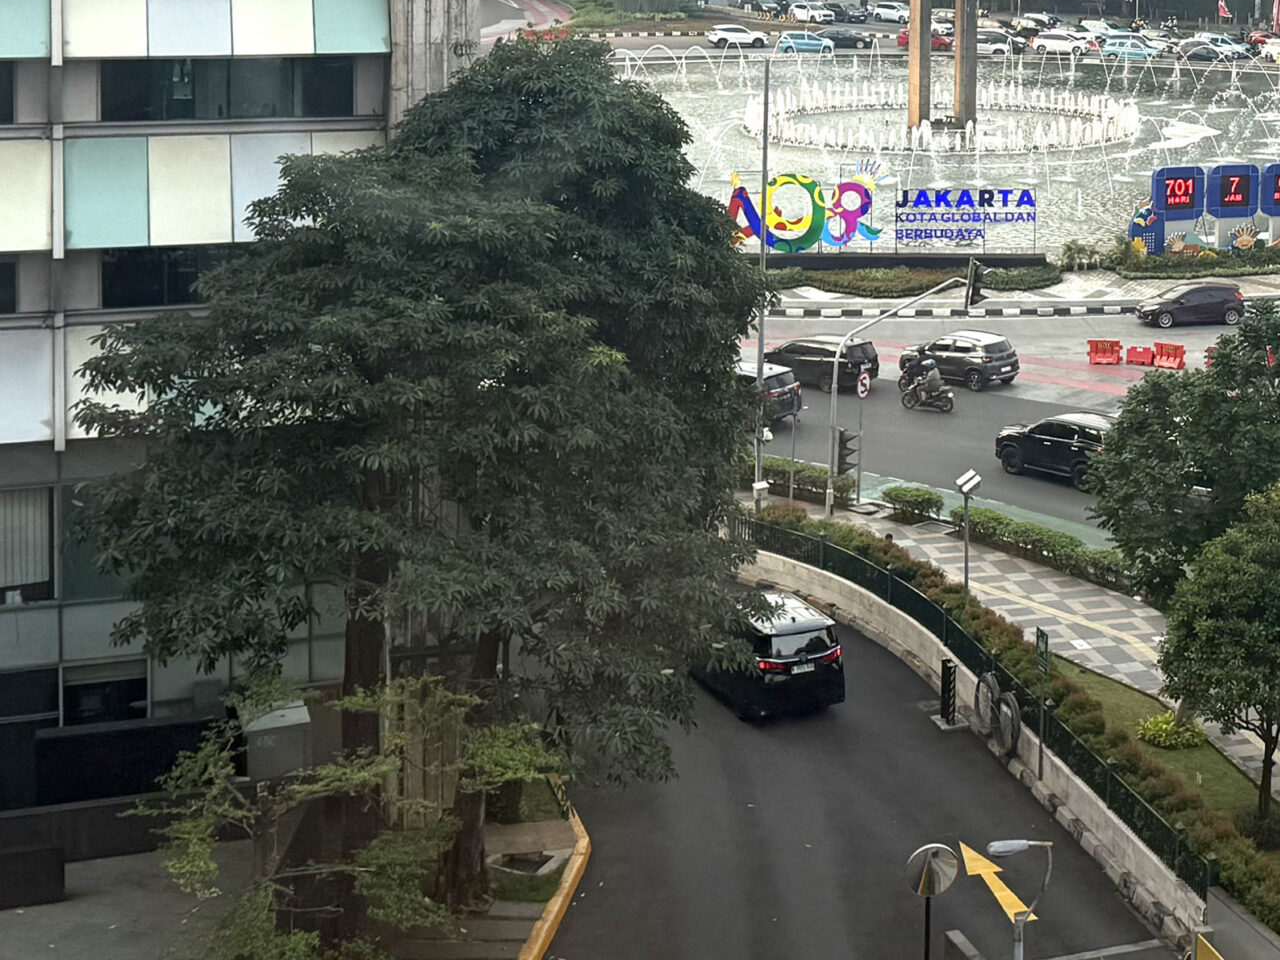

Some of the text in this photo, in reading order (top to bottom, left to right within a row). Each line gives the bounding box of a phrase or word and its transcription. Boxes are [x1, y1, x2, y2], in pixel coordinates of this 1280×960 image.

[1165, 178, 1194, 196] 701
[1229, 177, 1240, 193] 7
[896, 189, 1036, 208] JAKARTA
[1167, 196, 1190, 204] HARI
[896, 212, 1036, 222] KOTA GLOBAL DAN
[896, 228, 985, 240] BERBUDAYA
